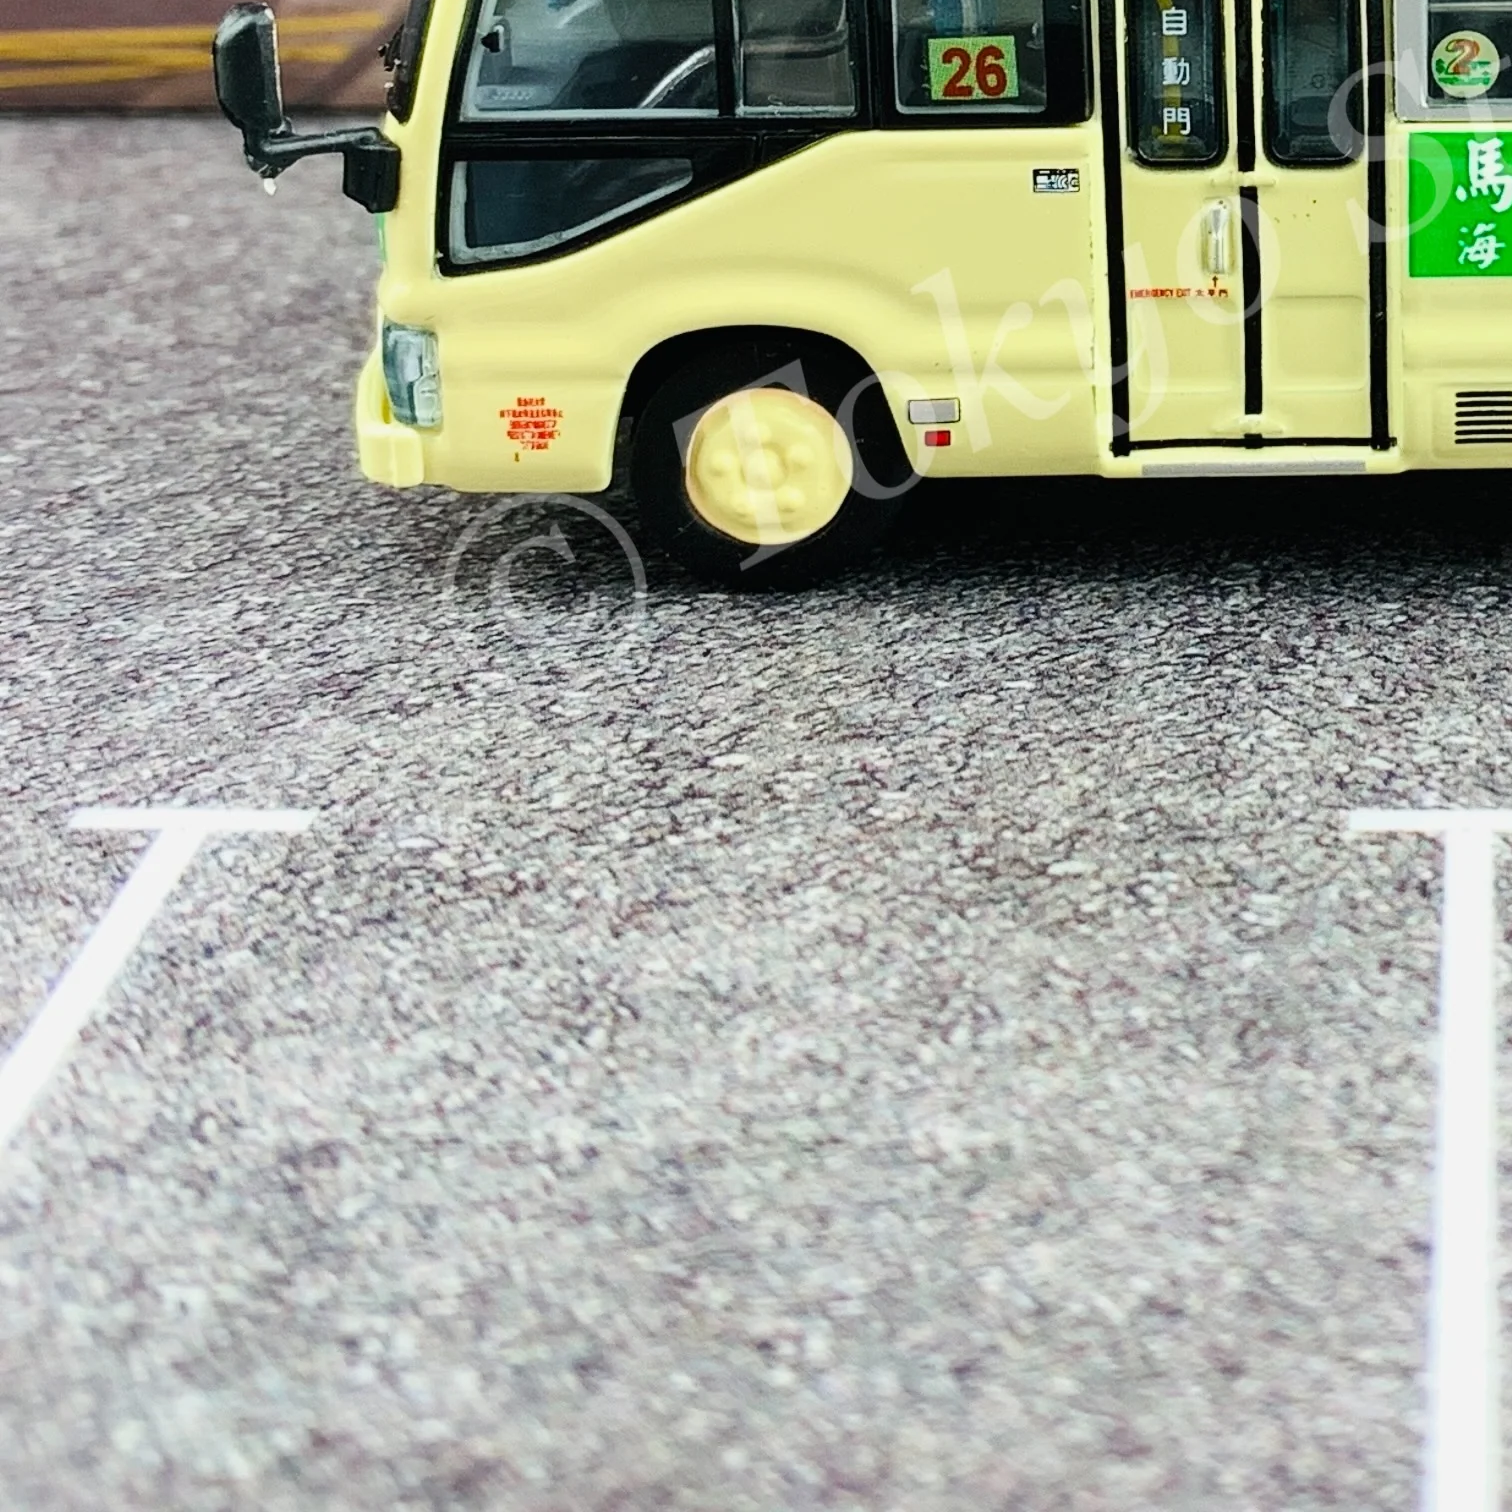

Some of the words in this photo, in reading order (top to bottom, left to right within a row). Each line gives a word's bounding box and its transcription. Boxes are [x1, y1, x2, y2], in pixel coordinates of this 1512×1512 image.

[940, 45, 1009, 98] 26
[1160, 7, 1192, 136] 自動門
